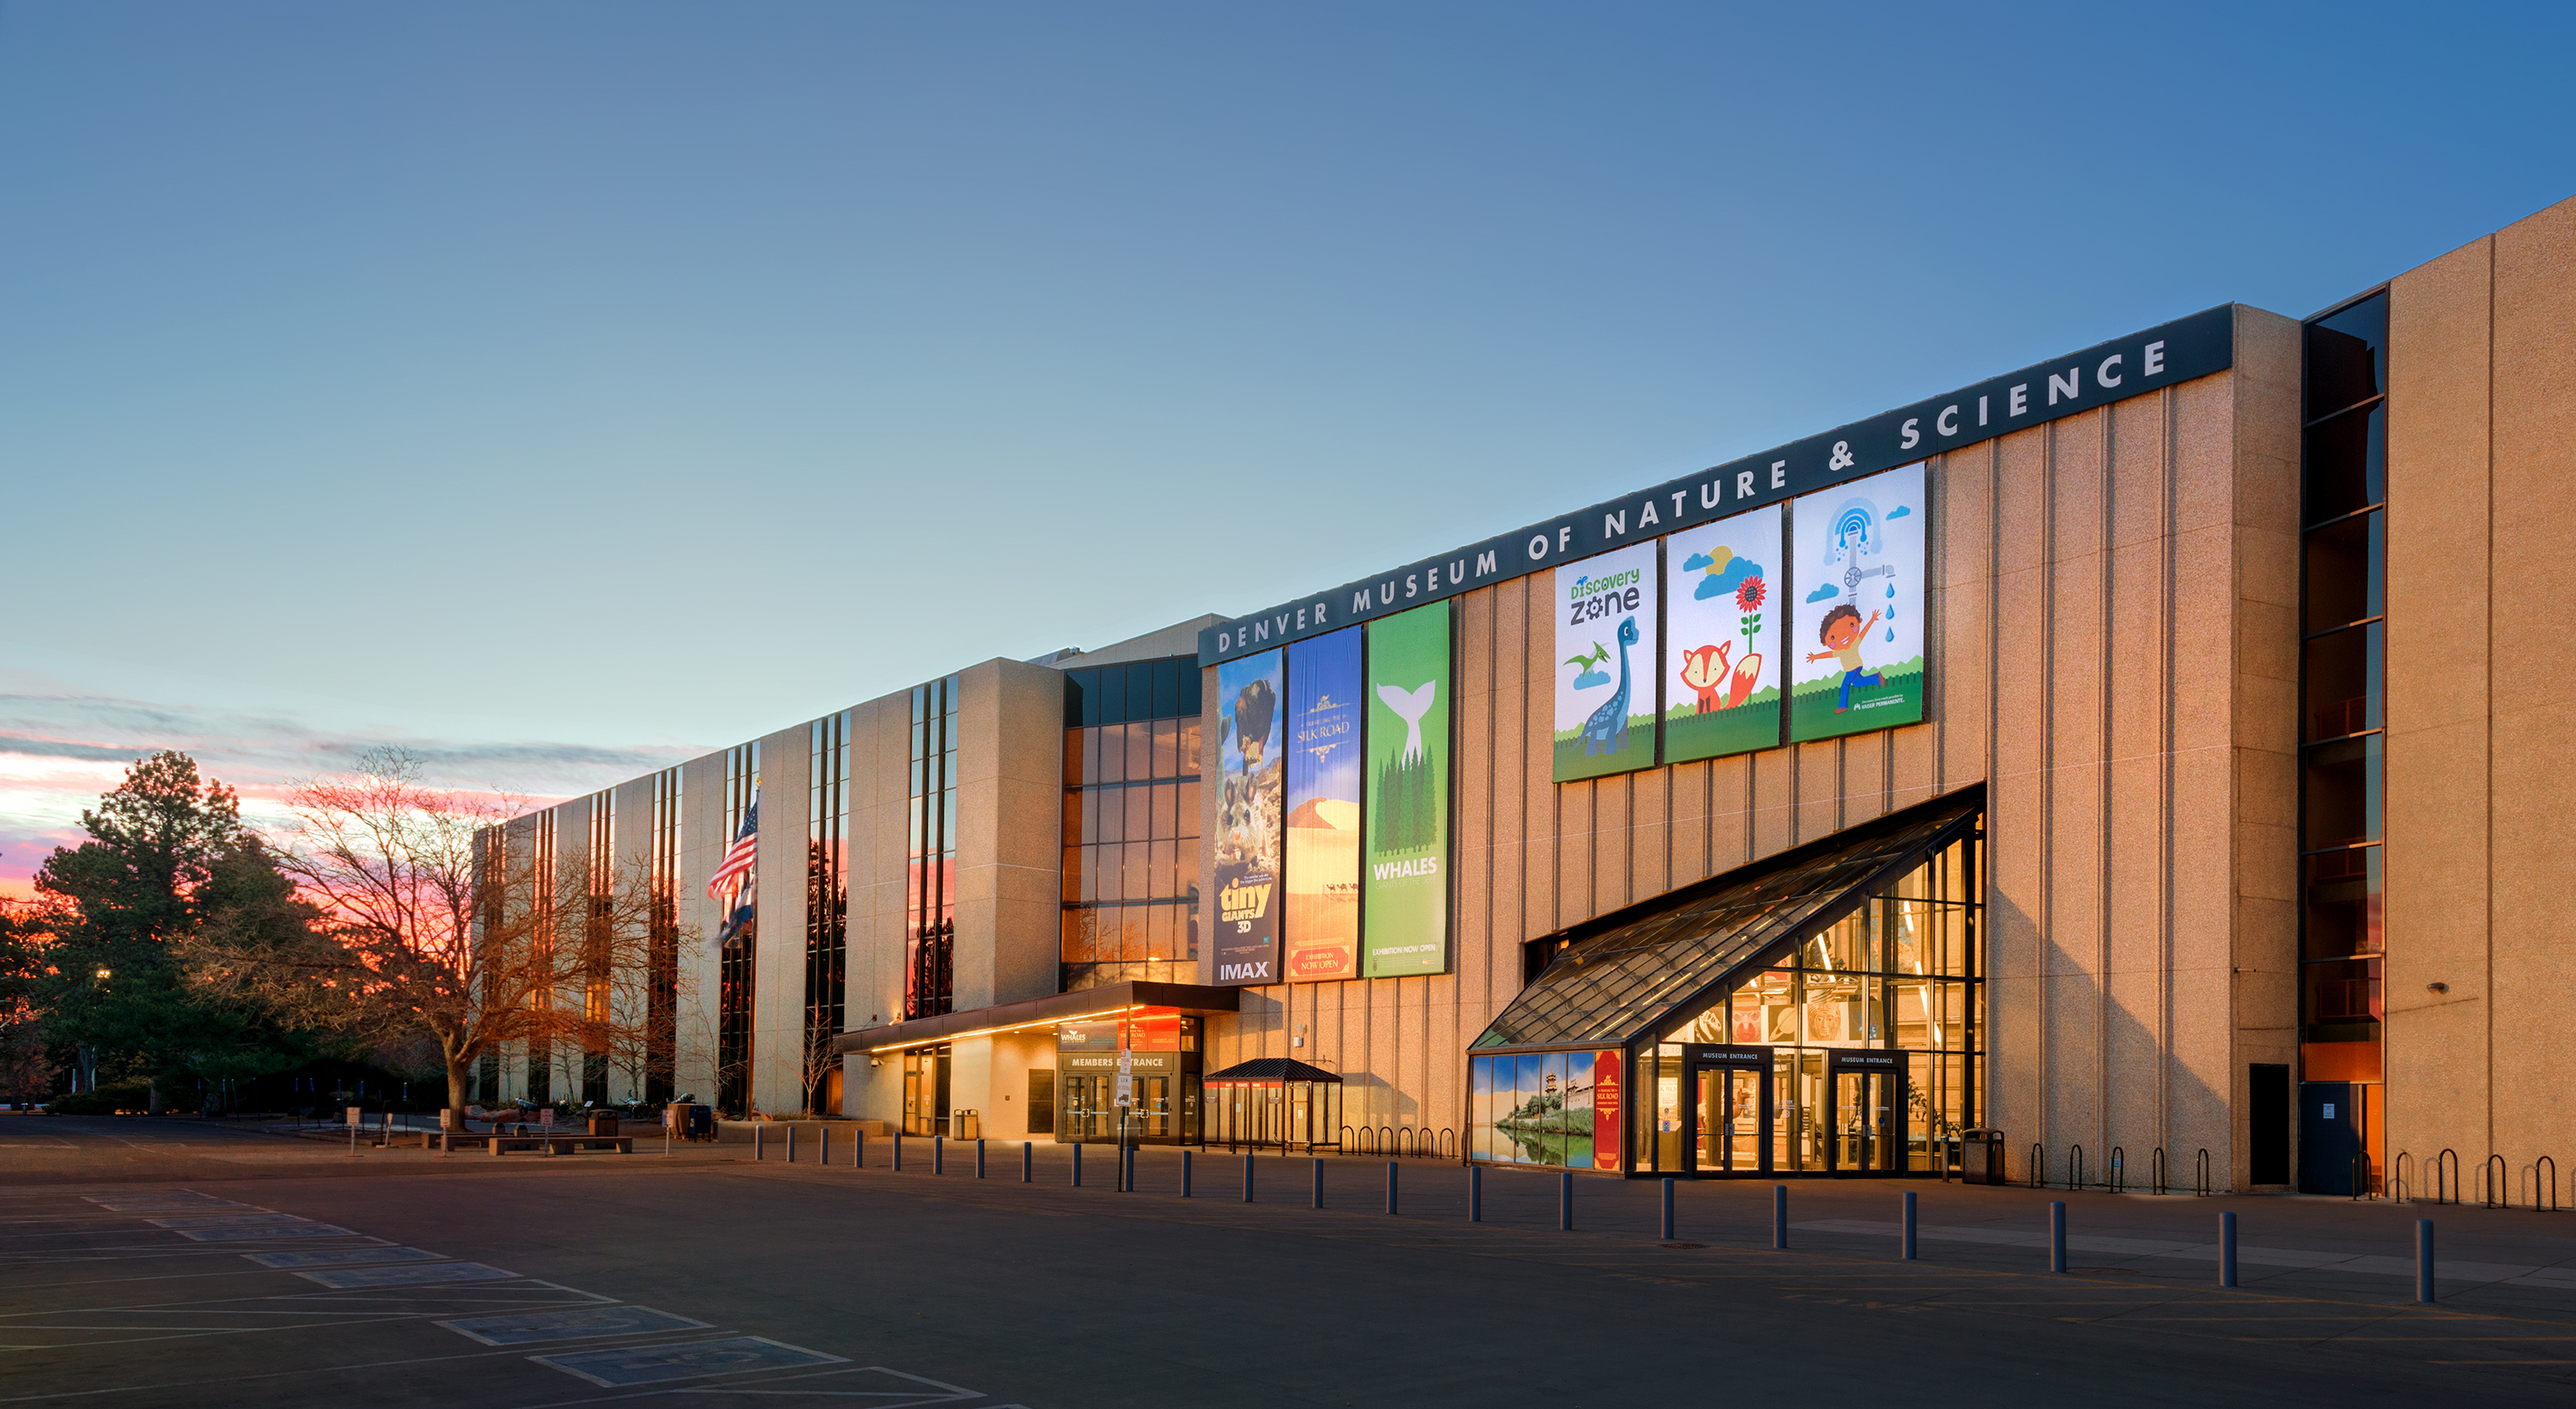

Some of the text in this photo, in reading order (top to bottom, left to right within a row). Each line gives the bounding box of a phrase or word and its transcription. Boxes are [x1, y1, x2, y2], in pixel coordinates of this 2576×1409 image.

[1219, 340, 2164, 653] DENVER MUSEUM OF NATURE & SCIENCE
[1297, 721, 1350, 741] SILK ROAD
[1374, 856, 1437, 881] WHALES
[1376, 880, 1398, 890] GIANTS
[1399, 878, 1408, 887] OF
[1409, 877, 1420, 886] THE
[1219, 877, 1273, 919] tiny
[1221, 908, 1255, 922] GIANTS
[1237, 920, 1252, 933] 3D
[1306, 952, 1334, 961] EXHIBITION
[1372, 946, 1402, 956] EXHIBITION
[1420, 944, 1436, 952] OPEN
[1220, 961, 1269, 981] IMAX
[1301, 960, 1339, 970] NOW OPEN
[1072, 1058, 1114, 1066] MEMBERS
[1116, 1058, 1163, 1066] ETRANCE
